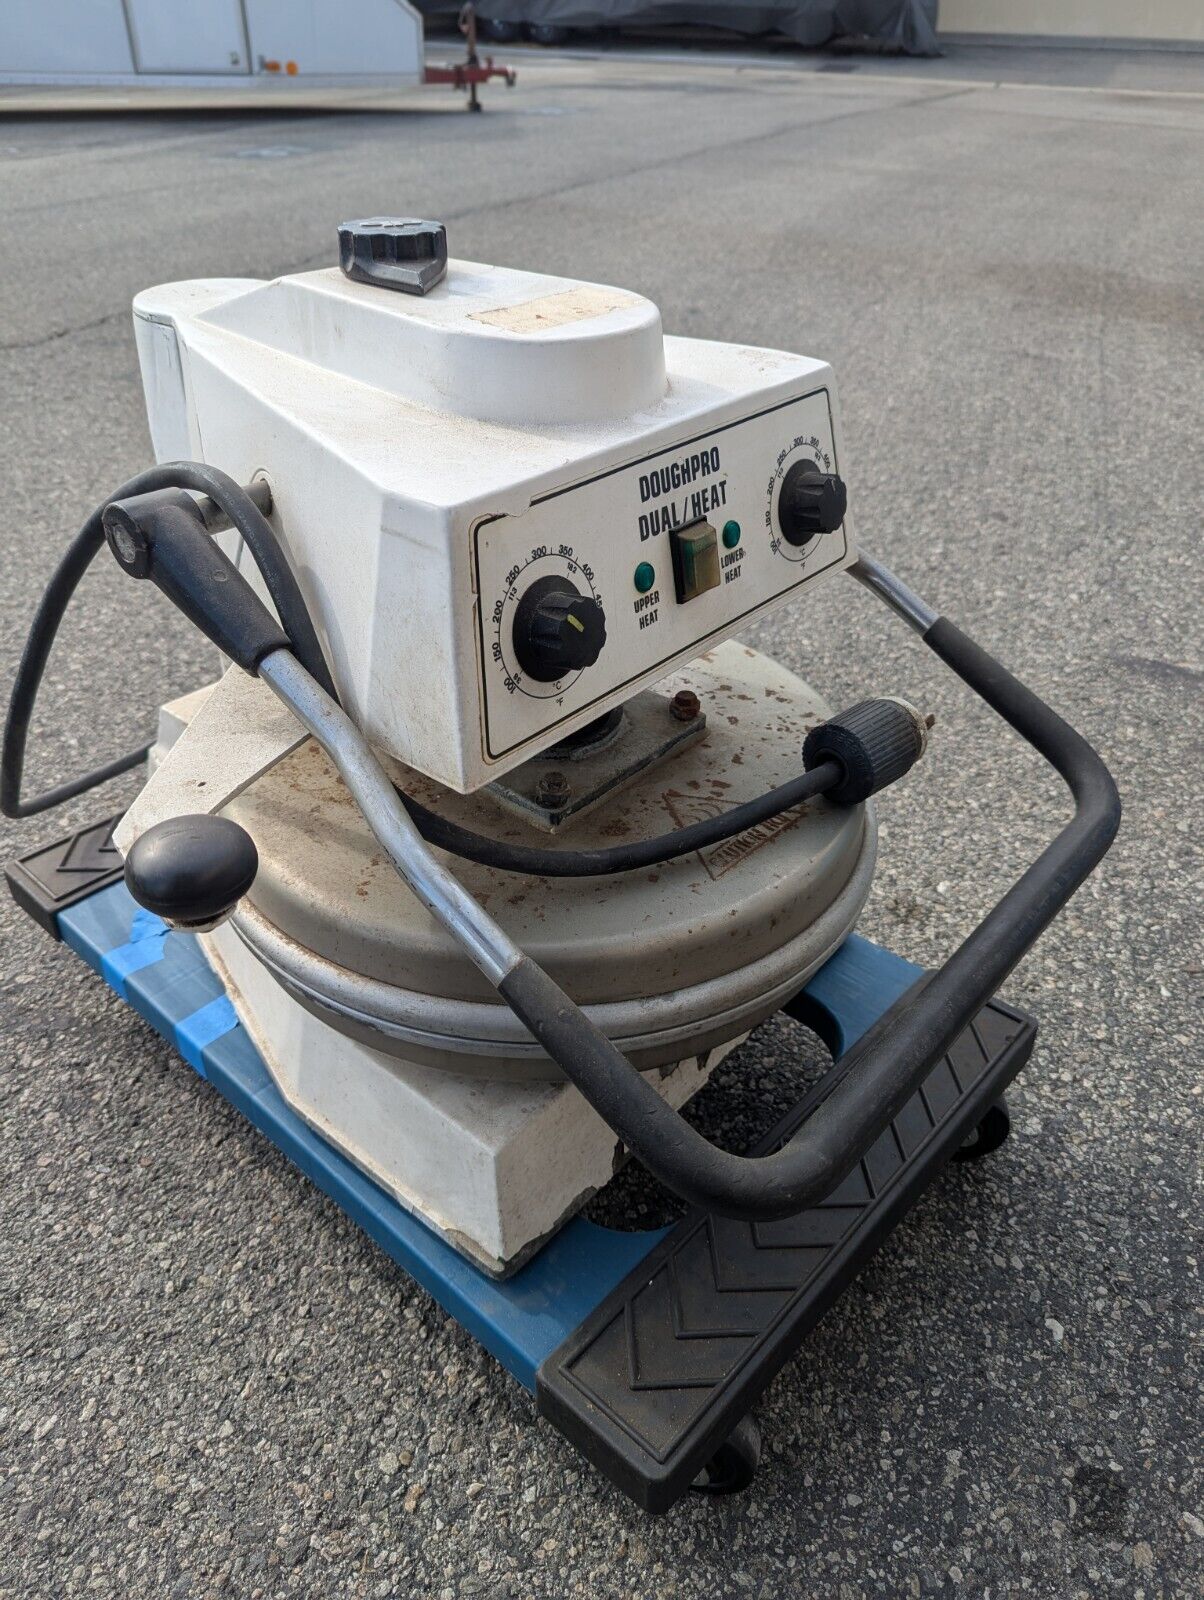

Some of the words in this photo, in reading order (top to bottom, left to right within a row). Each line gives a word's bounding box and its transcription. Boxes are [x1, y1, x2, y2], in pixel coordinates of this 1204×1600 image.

[639, 446, 720, 503] DOUGHPRO
[766, 476, 775, 496] 200
[531, 545, 547, 560] 300
[558, 544, 573, 557] 350
[721, 547, 744, 569] LOWER
[505, 565, 520, 586] 250
[566, 562, 578, 574] 182
[582, 563, 595, 581] 400
[725, 565, 742, 584] HEAT
[508, 587, 518, 602] 113
[633, 590, 660, 613] UPPER
[492, 600, 503, 624] 200
[639, 609, 659, 630] HEAT
[492, 642, 503, 663] 150
[503, 677, 516, 694] 100
